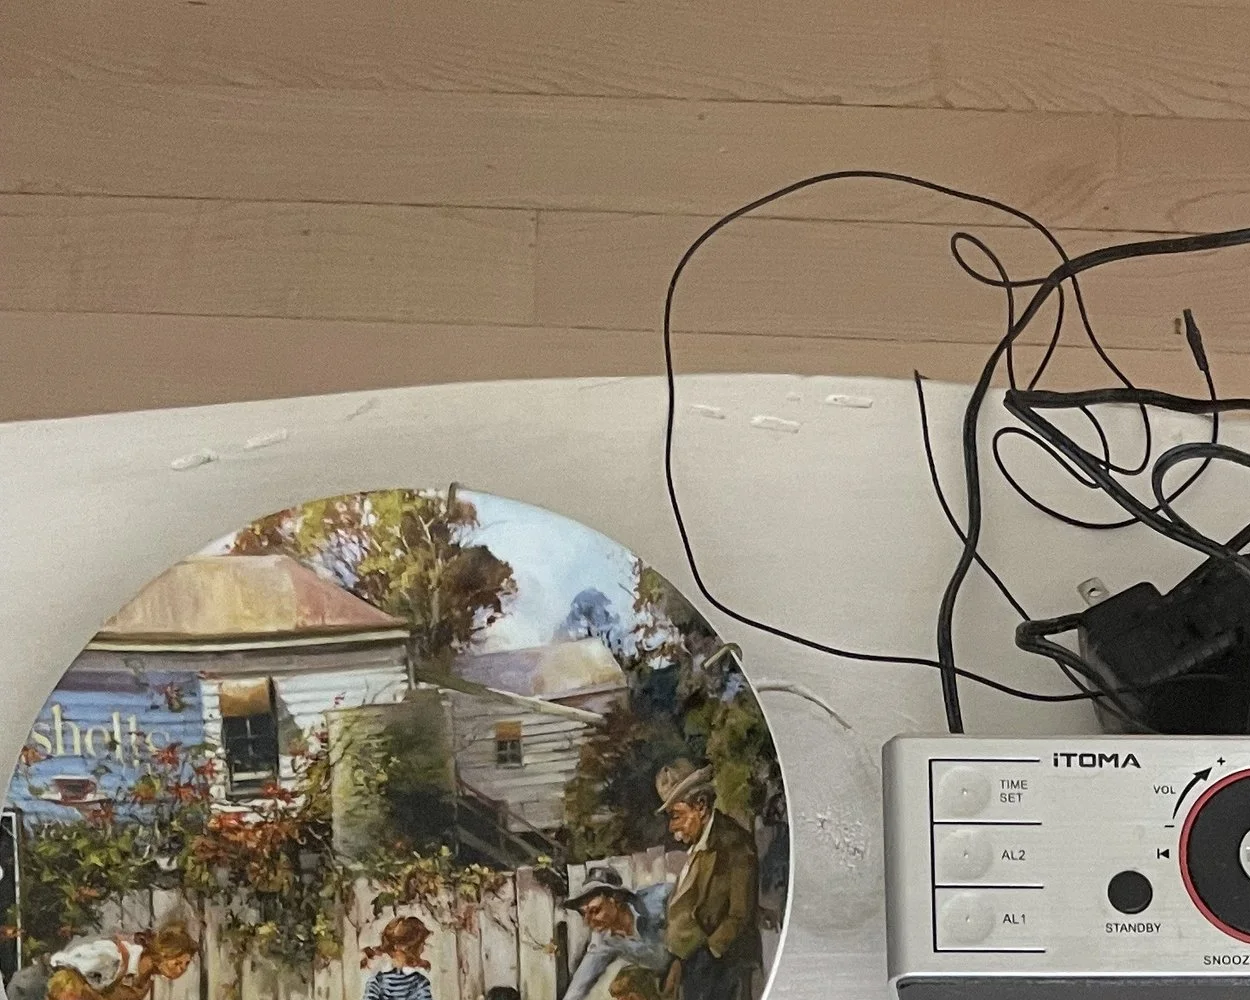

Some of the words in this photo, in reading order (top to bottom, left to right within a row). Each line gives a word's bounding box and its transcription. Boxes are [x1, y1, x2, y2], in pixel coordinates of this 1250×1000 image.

[1053, 753, 1141, 769] iTOMA
[1000, 779, 1028, 790] TIME
[1153, 785, 1176, 795] VOL
[1000, 793, 1023, 803] SET
[1001, 850, 1026, 861] AL2
[1003, 914, 1026, 924] AL1
[1105, 923, 1161, 933] STANDBY
